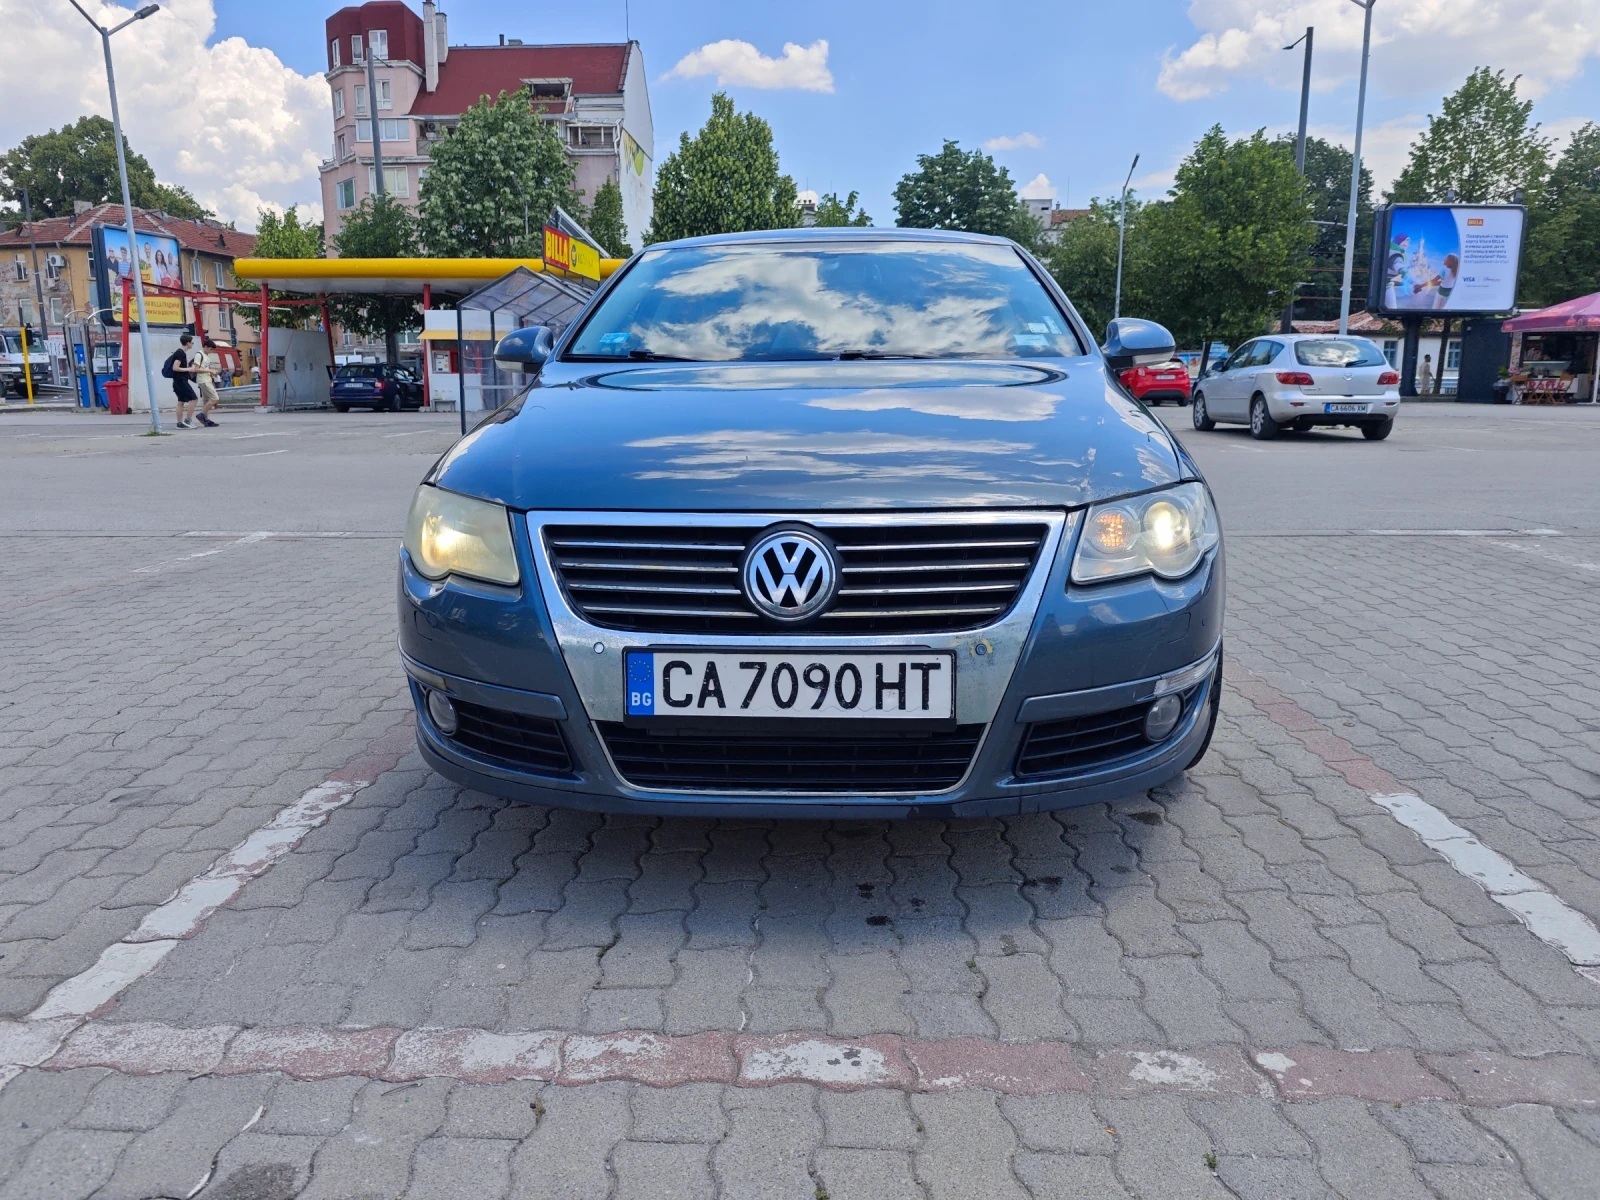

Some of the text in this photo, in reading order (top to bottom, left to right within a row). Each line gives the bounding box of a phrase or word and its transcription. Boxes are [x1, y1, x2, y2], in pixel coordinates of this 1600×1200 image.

[545, 230, 568, 265] BILLA
[631, 691, 652, 707] BG
[663, 660, 942, 711] CA 7090 HT
